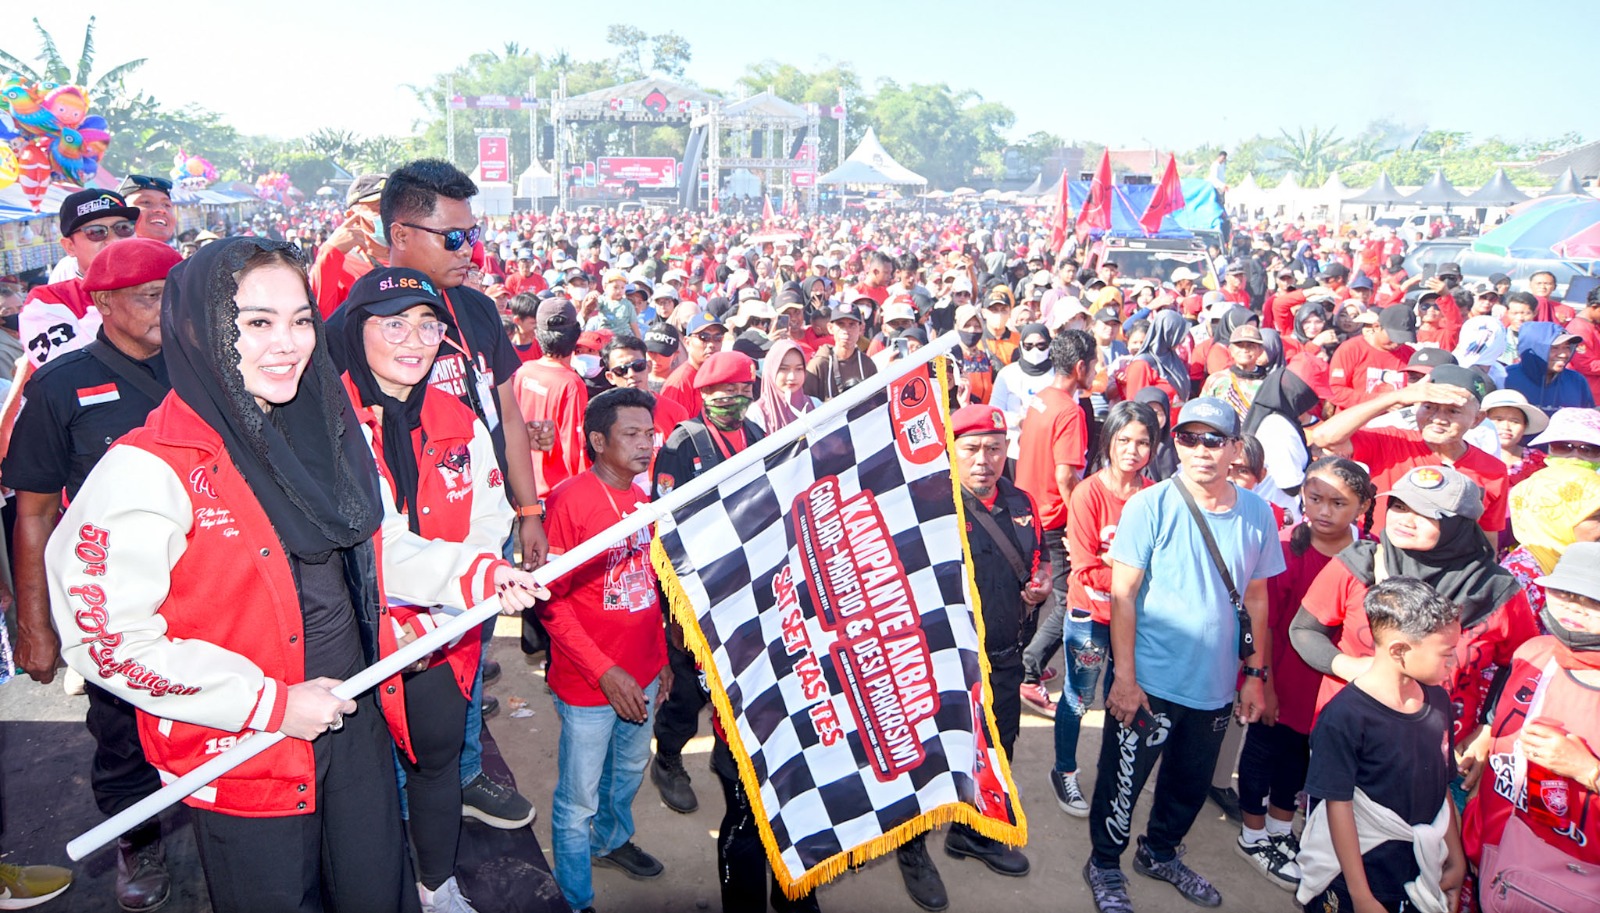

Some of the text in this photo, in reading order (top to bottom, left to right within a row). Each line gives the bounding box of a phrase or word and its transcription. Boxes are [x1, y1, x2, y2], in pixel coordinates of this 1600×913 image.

[28, 322, 77, 363] 33
[840, 495, 933, 723] KAMPANYE AKBAR
[845, 617, 873, 638] &
[771, 566, 845, 747] SAT SET TAS TES
[852, 637, 888, 679] DESI
[865, 674, 920, 768] PRAKASIWI
